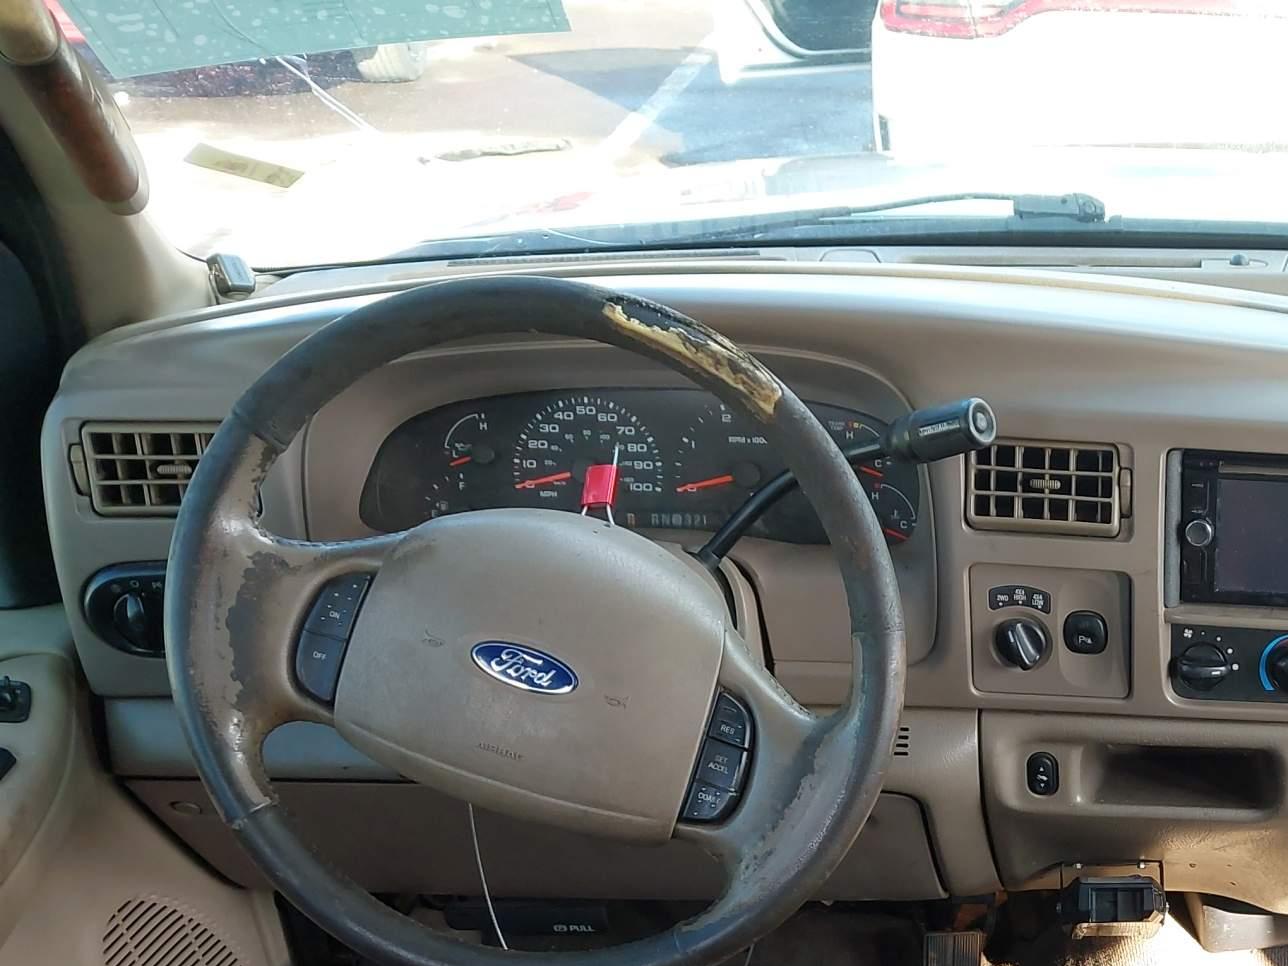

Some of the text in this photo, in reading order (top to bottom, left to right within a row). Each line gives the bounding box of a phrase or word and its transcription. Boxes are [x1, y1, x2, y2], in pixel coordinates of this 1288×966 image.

[576, 406, 596, 415] 50
[554, 411, 574, 420] 40
[598, 413, 617, 422] 60
[721, 414, 732, 422] 2
[480, 422, 487, 431] H
[539, 424, 559, 432] 30
[616, 426, 635, 435] 70
[528, 440, 548, 448] 20
[627, 443, 647, 452] 80
[522, 460, 537, 468] 10
[634, 461, 653, 470] 90
[875, 459, 882, 467] C
[459, 482, 465, 490] F
[629, 483, 653, 491] 100
[900, 521, 908, 529] C
[996, 594, 1009, 602] 2WD
[329, 610, 340, 619] ON
[312, 650, 326, 660] OFF
[490, 648, 556, 687] Ford
[720, 724, 735, 735] RES
[569, 924, 595, 932] PULL
